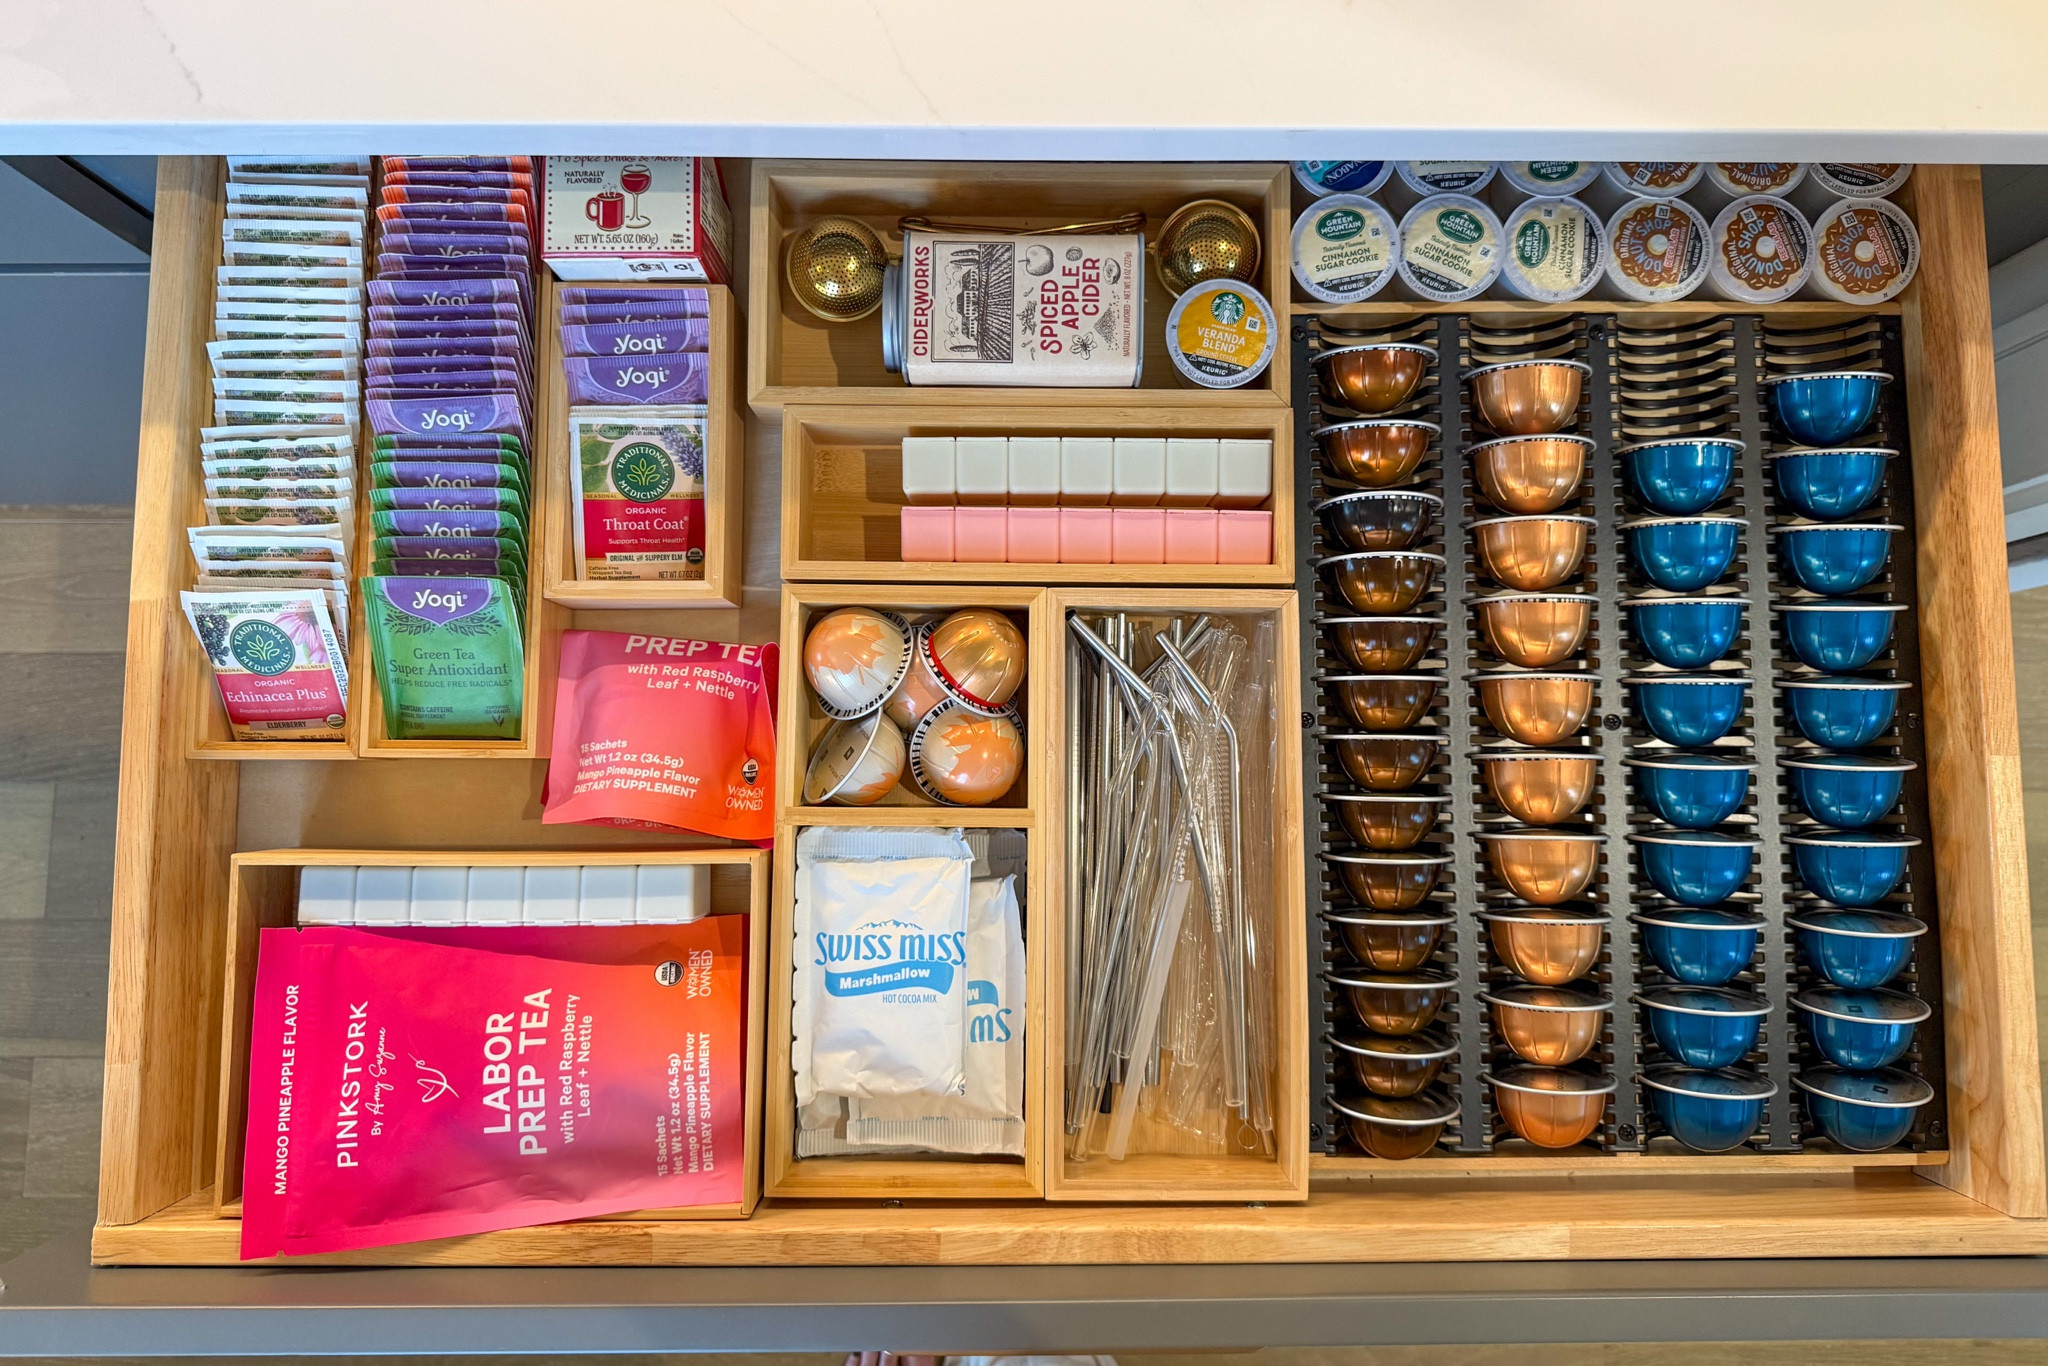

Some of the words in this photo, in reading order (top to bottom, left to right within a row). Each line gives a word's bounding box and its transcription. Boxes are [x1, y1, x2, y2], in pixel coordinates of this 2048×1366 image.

[1440, 180, 1466, 188] KEURIG
[1731, 168, 1771, 186] ORIGINAL
[1838, 174, 1865, 185] KEURIG
[1321, 220, 1361, 234] MOUNTAIN
[1326, 216, 1353, 226] GREEN
[1441, 218, 1479, 238] MOUNTAIN
[1449, 215, 1475, 230] GREEN
[1568, 217, 1576, 248] COOKIE
[1636, 219, 1672, 236] SHOP
[574, 234, 590, 244] NET
[606, 234, 622, 244] 5.65
[623, 234, 634, 244] OZ
[635, 234, 658, 246] (160g)
[1524, 230, 1532, 257] GREEN
[1531, 224, 1540, 263] MOUNTAIN
[1559, 223, 1568, 270] CINNAMON
[1620, 220, 1637, 259] ORIGINAL
[1738, 220, 1764, 250] SHOP
[1766, 222, 1789, 261] REGULAR
[1837, 224, 1864, 253] SHOP
[1867, 227, 1889, 266] REGULAR
[1894, 226, 1907, 249] KEURIG
[1322, 248, 1370, 262] CINNAMON
[1424, 242, 1470, 265] CINNAMON
[1630, 238, 1662, 272] DONUT
[1663, 228, 1680, 268] REGULAR
[1692, 241, 1702, 266] KEURIG
[1728, 240, 1749, 279] ORIGINAL
[1316, 261, 1344, 272] SUGAR
[1346, 254, 1379, 266] COOKIE
[1414, 246, 1441, 263] SUGAR
[1442, 258, 1473, 277] COOKIE
[1565, 250, 1574, 278] SUGAR
[1740, 252, 1784, 275] DONUT
[1826, 244, 1847, 282] ORIGINAL
[1839, 257, 1882, 280] DONUT
[1082, 257, 1100, 316] CIDER
[1339, 282, 1365, 291] KEURIG
[1422, 276, 1446, 290] KEURIG
[913, 245, 934, 356] CIDERWORKS
[1062, 266, 1079, 330] APPLE
[1040, 279, 1063, 355] SPICED
[1197, 326, 1246, 346] VERANDA
[1202, 338, 1236, 353] BLEND
[1202, 365, 1228, 376] KEURIG
[616, 446, 669, 470] TRADITIONAL
[618, 478, 670, 499] MEDICINALS
[603, 518, 650, 531] Throat
[654, 518, 684, 531] Coat
[234, 623, 286, 646] TRADITIONAL
[625, 635, 708, 657] PREP
[240, 652, 291, 673] MEDICINALS
[413, 648, 450, 660] Green
[454, 648, 475, 660] Tea
[390, 660, 424, 676] Super
[427, 663, 508, 676] Antioxidant
[628, 664, 658, 675] with
[662, 665, 689, 677] Red
[693, 667, 760, 694] Raspberry
[254, 678, 295, 687] ORGANIC
[391, 679, 413, 687] HELPS
[414, 680, 445, 688] REDUCE
[448, 680, 468, 688] FREE
[647, 678, 679, 690] Leaf
[683, 681, 691, 689] +
[696, 680, 735, 700] Nettle
[226, 691, 293, 703] Echinacea
[297, 688, 327, 700] Plus
[267, 721, 306, 729] ELDERBERRY
[580, 743, 589, 753] 15
[590, 739, 627, 752] Sachets
[580, 757, 593, 767] Net
[594, 754, 606, 765] Wt
[608, 753, 620, 762] 1.2
[624, 754, 637, 762] oz
[640, 754, 684, 768] (34.5g)
[577, 768, 605, 782] Mango
[606, 765, 660, 780] Pineapple
[664, 770, 700, 785] Flavor
[573, 779, 612, 795] DIETARY
[613, 778, 697, 799] SUPPLEMENT
[725, 797, 763, 811] OWNED
[699, 950, 713, 997] OWNED
[839, 966, 931, 990] Marshmallow
[882, 994, 897, 1003] HOT
[898, 994, 921, 1004] COCOA
[923, 994, 937, 1003] MIX
[283, 984, 300, 1044] FLAVOR
[518, 988, 552, 1055] TEA
[559, 994, 580, 1071] Raspberry
[577, 1015, 593, 1063] Nettle
[684, 1032, 695, 1072] Flavor
[483, 1012, 515, 1133] LABOR
[579, 1068, 588, 1077] +
[668, 1054, 681, 1099] (34.5g)
[699, 1032, 711, 1118] SUPPLEMENT
[278, 1048, 296, 1132] PINEAPPLE
[336, 1001, 368, 1168] PINKSTORK
[559, 1075, 572, 1106] Red
[365, 1081, 394, 1115] Amy
[518, 1064, 548, 1155] PREP
[576, 1082, 591, 1118] Leaf
[672, 1102, 680, 1115] oz
[684, 1074, 697, 1134] Pineapple
[371, 1120, 384, 1136] By
[560, 1108, 574, 1144] with
[670, 1118, 681, 1134] 1.2
[656, 1115, 667, 1162] Sachets
[671, 1136, 682, 1154] Wt
[701, 1122, 714, 1171] DIETARY
[274, 1135, 290, 1195] MANGO
[673, 1155, 684, 1175] Net
[688, 1136, 699, 1173] Mango
[658, 1164, 668, 1176] 15
